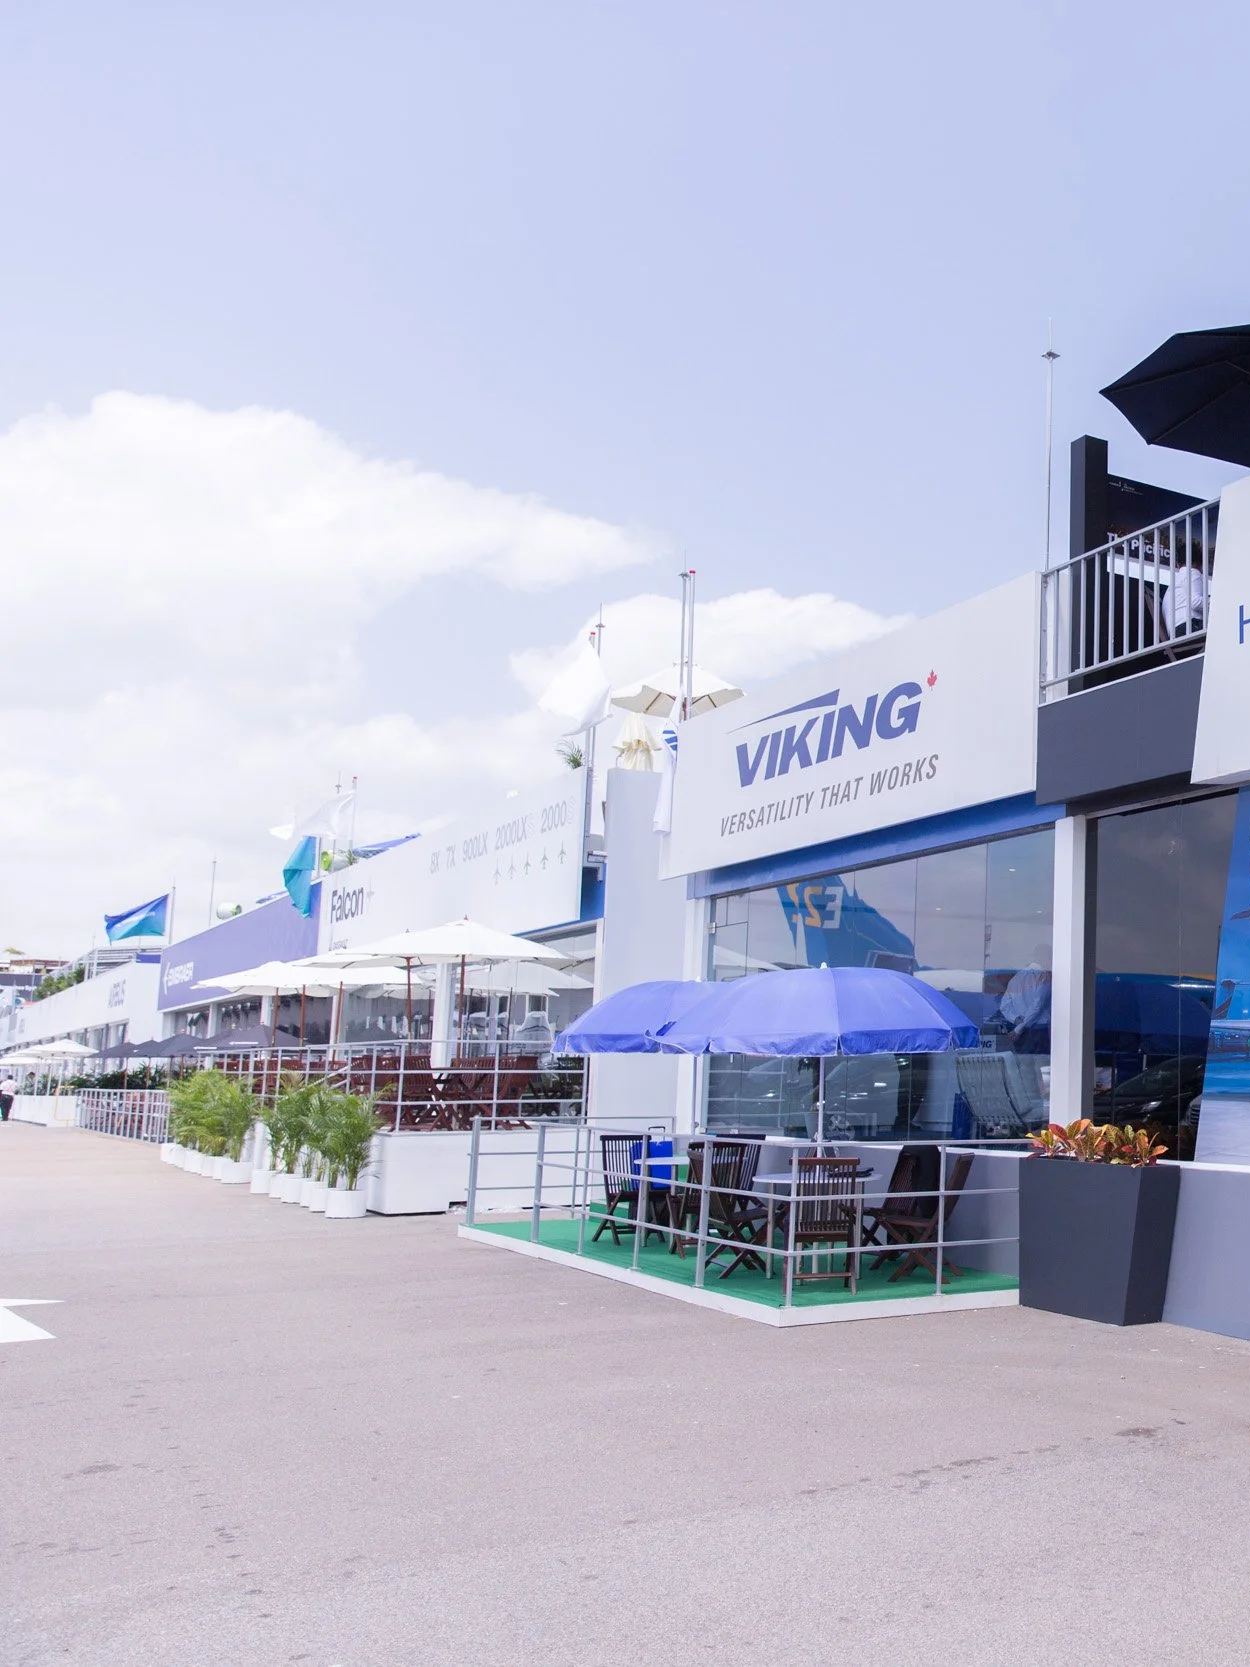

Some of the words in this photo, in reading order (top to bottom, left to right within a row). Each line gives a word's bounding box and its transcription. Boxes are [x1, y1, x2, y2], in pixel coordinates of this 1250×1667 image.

[735, 681, 923, 787] VIKING
[720, 791, 815, 836] VERSATILITY
[820, 776, 863, 808] THAT
[869, 754, 939, 796] WORKS
[330, 887, 364, 924] Falcon
